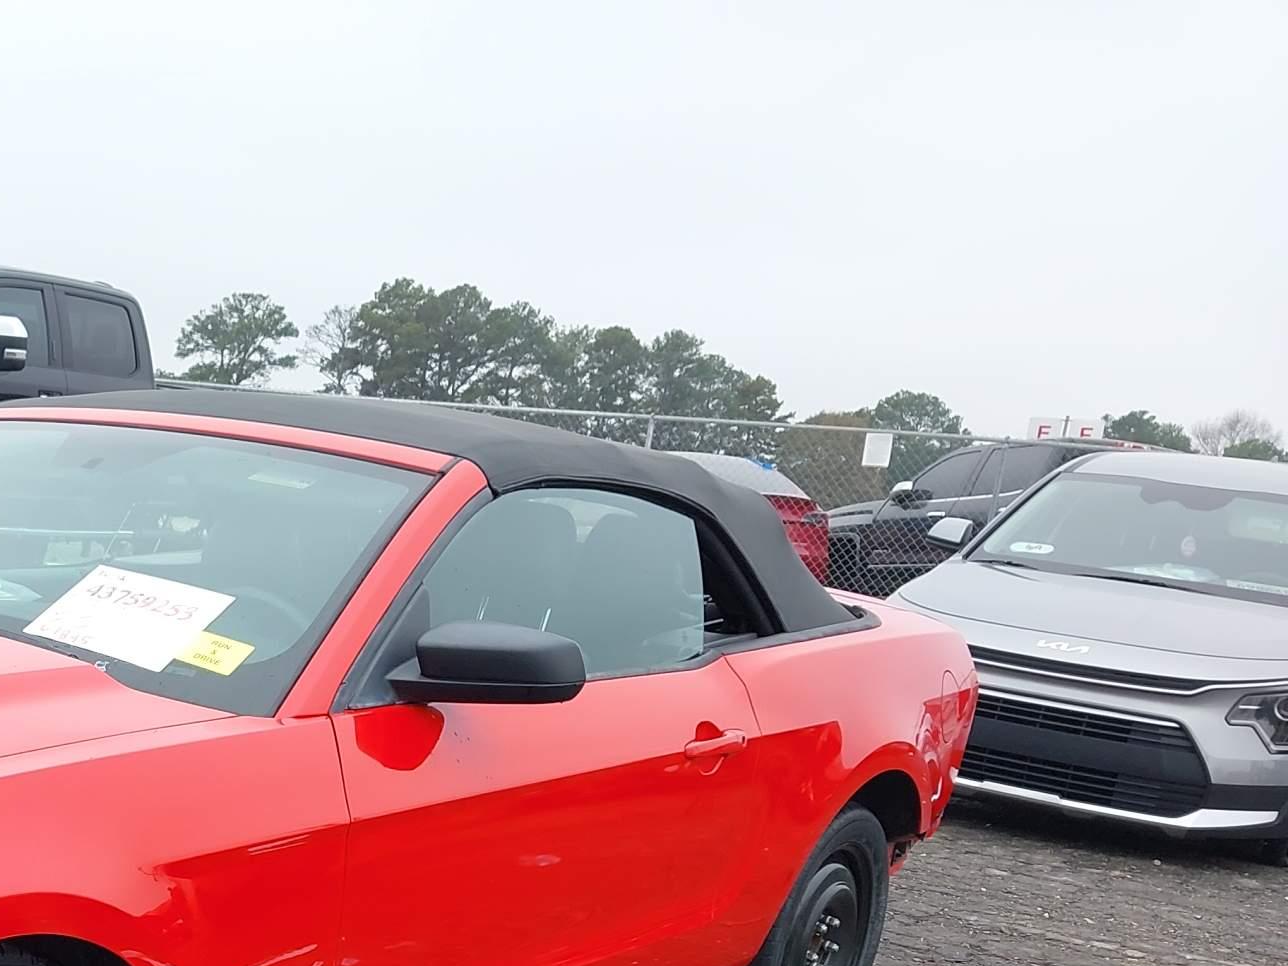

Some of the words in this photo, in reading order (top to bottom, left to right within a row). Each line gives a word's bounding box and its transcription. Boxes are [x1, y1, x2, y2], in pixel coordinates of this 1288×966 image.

[86, 584, 199, 621] 43759253
[210, 640, 232, 650] RUN
[192, 653, 222, 665] DRIVE
